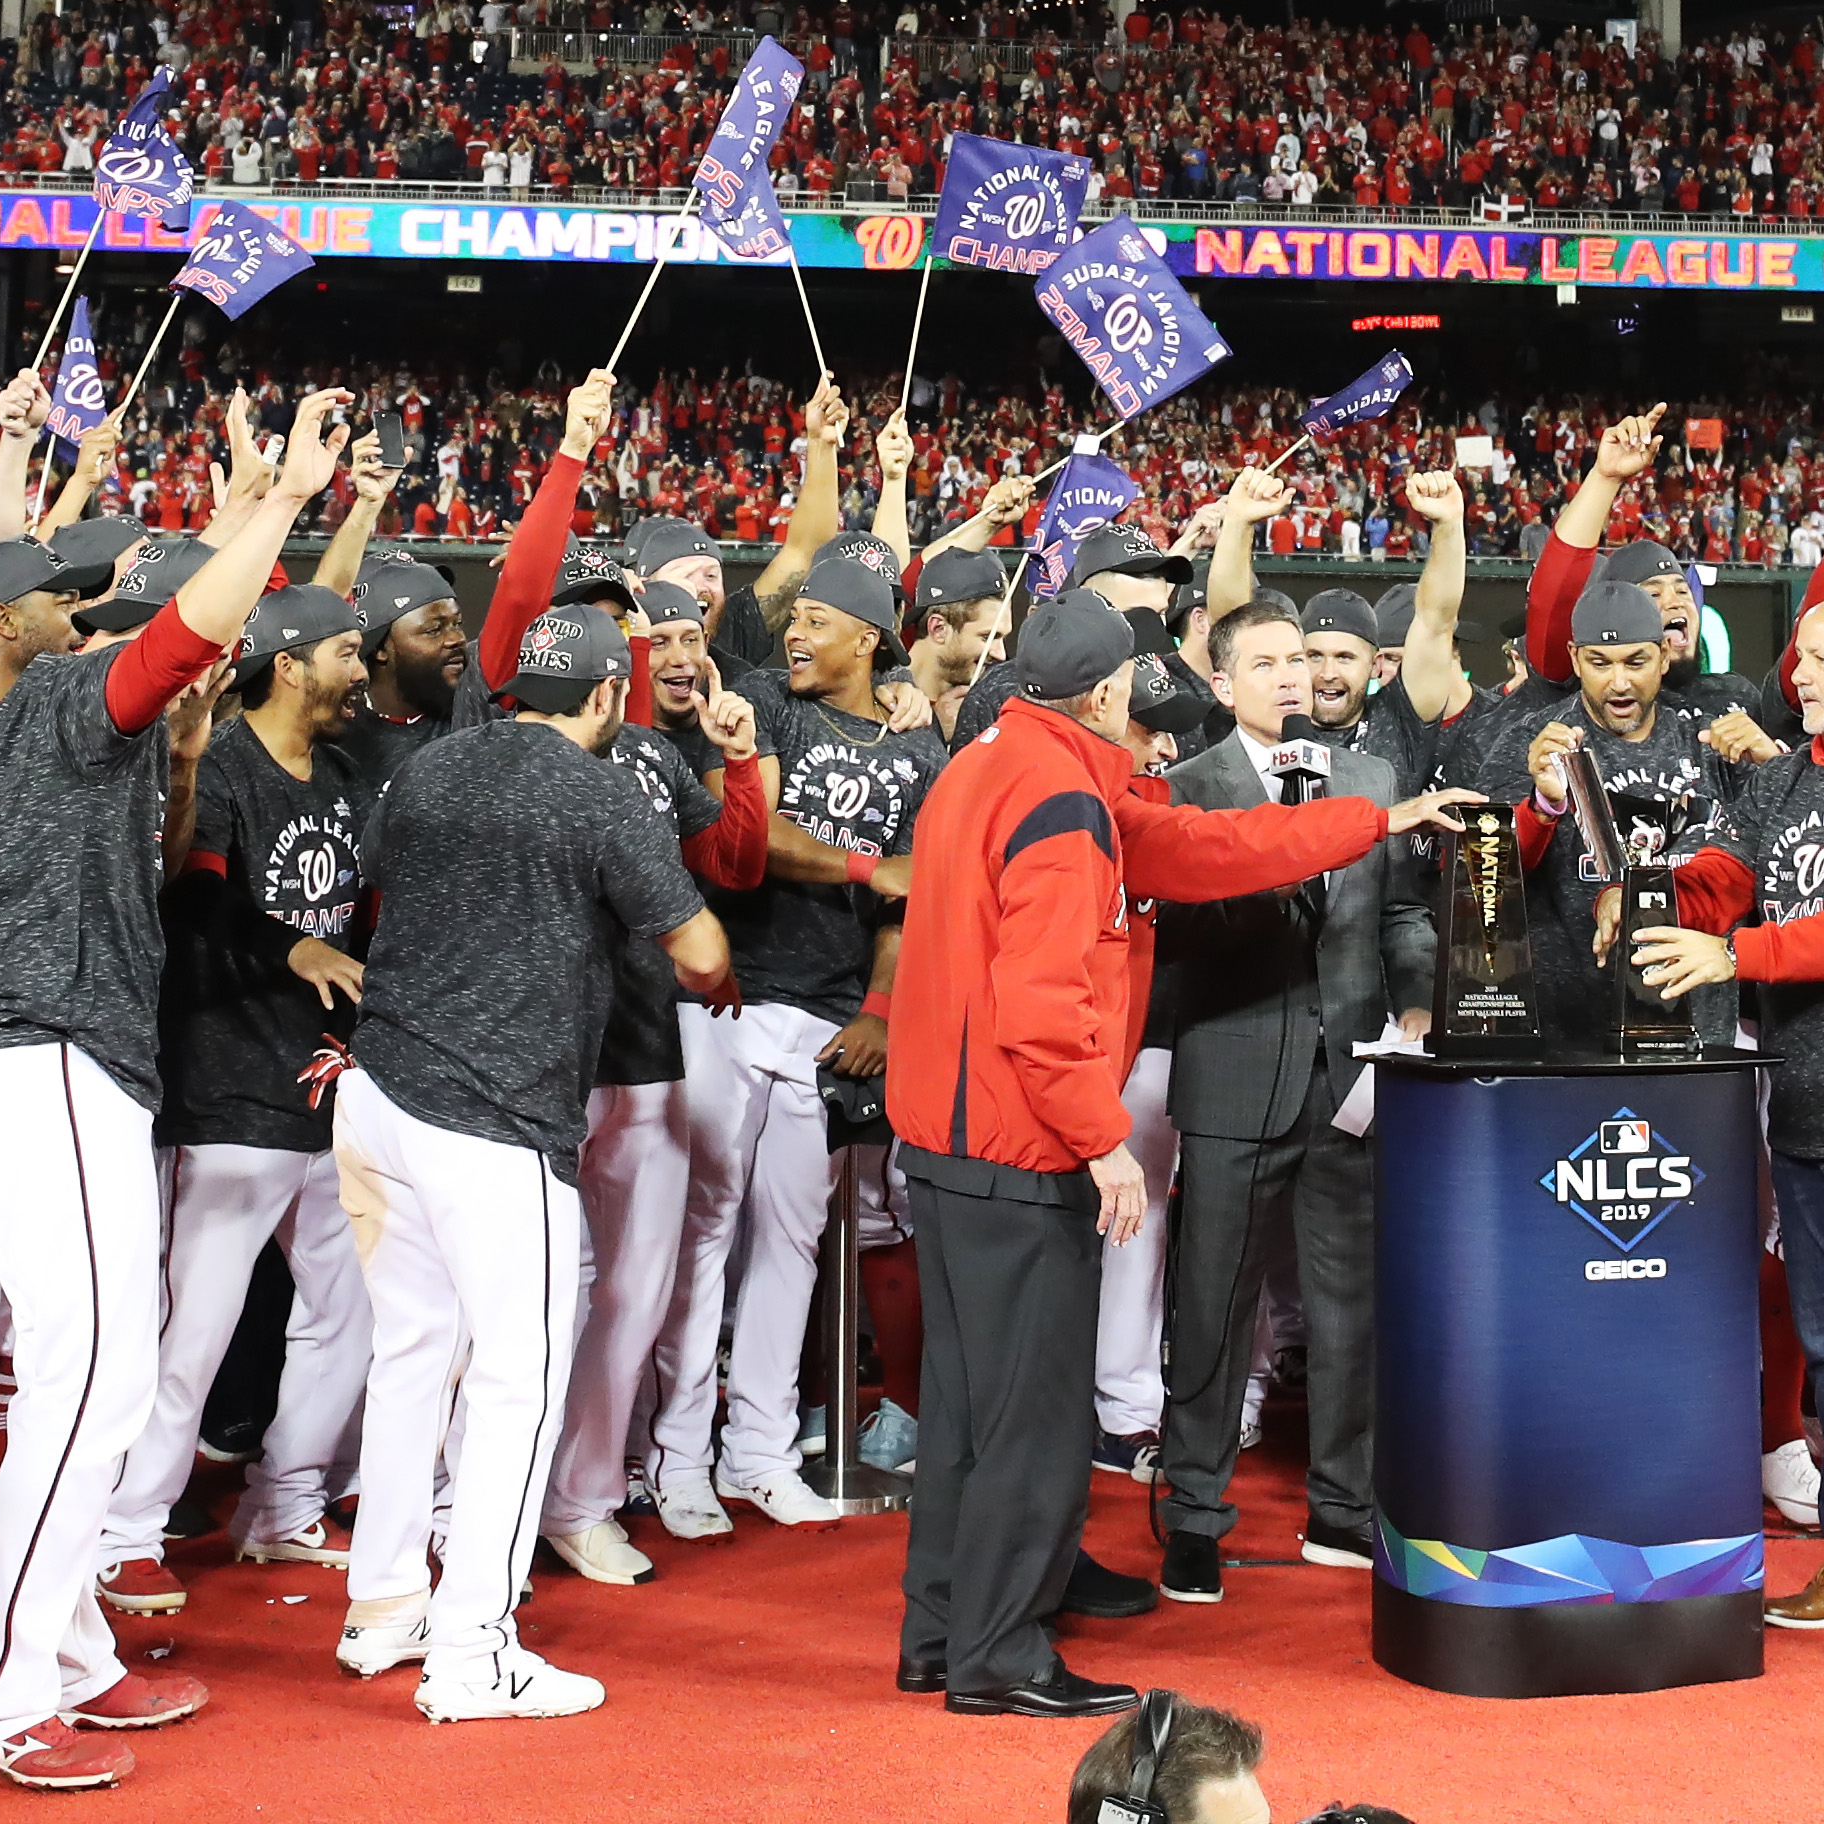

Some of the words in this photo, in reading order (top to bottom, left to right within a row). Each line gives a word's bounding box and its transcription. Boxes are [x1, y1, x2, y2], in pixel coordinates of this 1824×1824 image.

[740, 66, 776, 171] LEAGUE
[105, 202, 373, 253] LEUE
[959, 165, 1040, 230] NATIONAL
[1043, 170, 1067, 245] LEAGUE
[982, 212, 1006, 226] WSH
[1195, 228, 1528, 283] NATIONAL
[1540, 237, 1797, 287] LEAGUE
[1272, 749, 1299, 768] tbs
[783, 744, 862, 805] NATIONAL
[867, 758, 902, 841] LEAGUE
[264, 814, 319, 902] NATIONAL
[1480, 835, 1498, 927] NATIONAL
[1457, 1009, 1476, 1017] MOST
[1555, 1156, 1693, 1202] NLCS
[1600, 1204, 1651, 1221] 2019
[1584, 1258, 1667, 1280] GEICO
